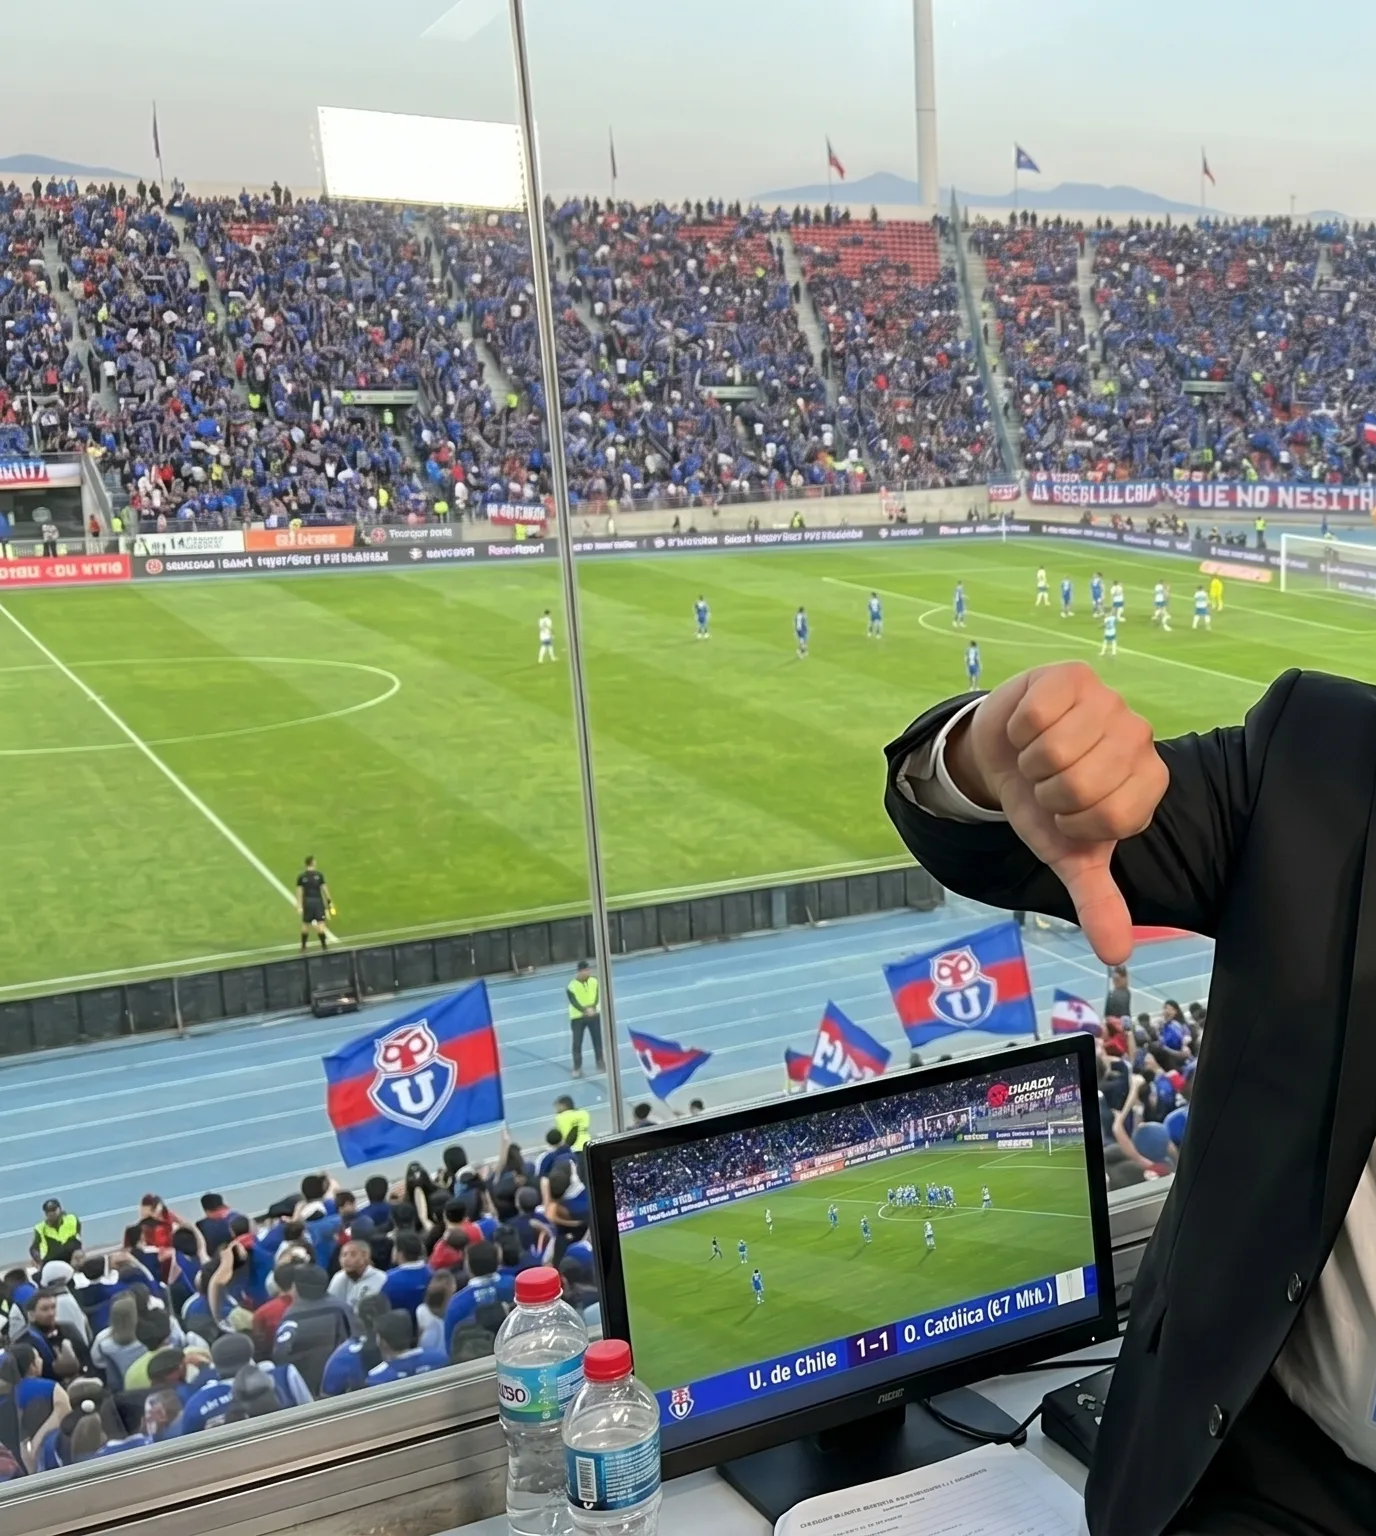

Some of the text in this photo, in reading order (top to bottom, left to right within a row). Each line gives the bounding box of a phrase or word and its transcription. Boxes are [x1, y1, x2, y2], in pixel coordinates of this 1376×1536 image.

[945, 986, 980, 1020] U
[390, 1070, 434, 1114] U
[856, 1331, 889, 1358] 1-1
[749, 1351, 837, 1390] U. de Chile
